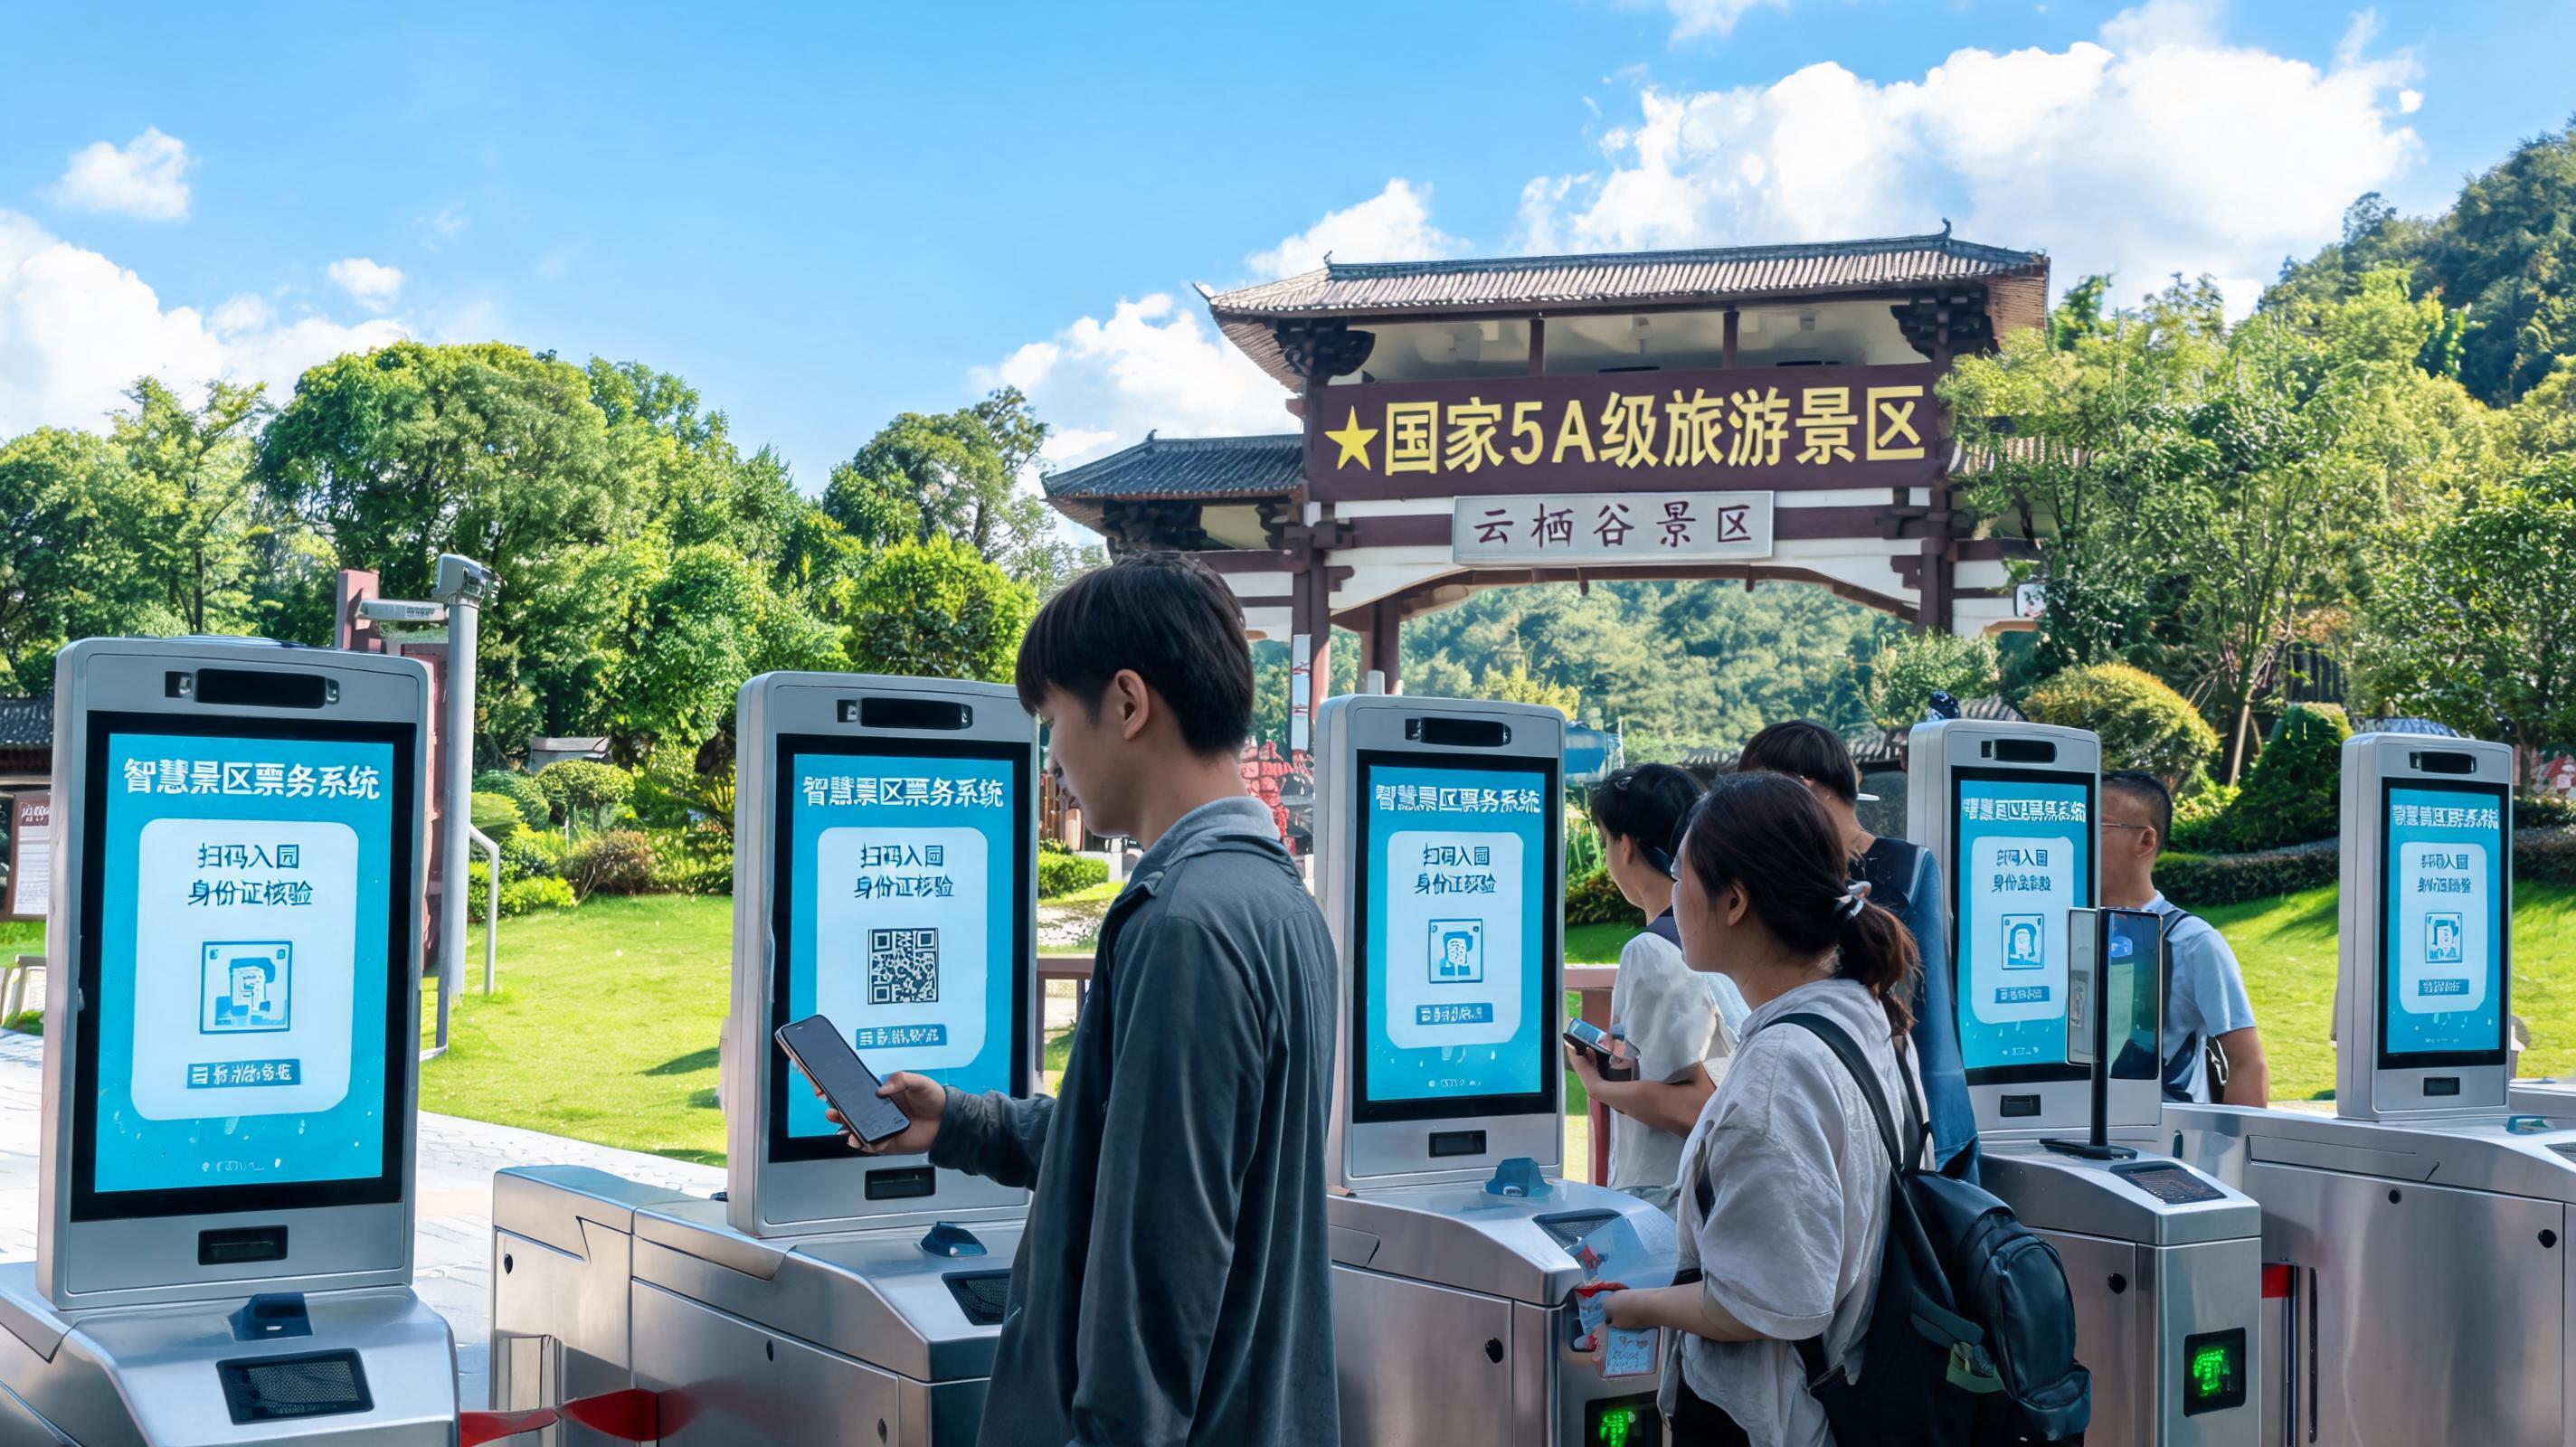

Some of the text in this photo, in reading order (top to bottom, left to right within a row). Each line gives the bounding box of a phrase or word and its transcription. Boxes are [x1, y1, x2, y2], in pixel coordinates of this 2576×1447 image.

[1385, 385, 1926, 477] 国家5A级旅游景区
[1473, 501, 1752, 549] 云栖谷景区
[123, 758, 380, 800] 智慧景区票务系统
[802, 776, 1004, 808] 智慧景区票务系统
[187, 879, 314, 906] 身份证核验
